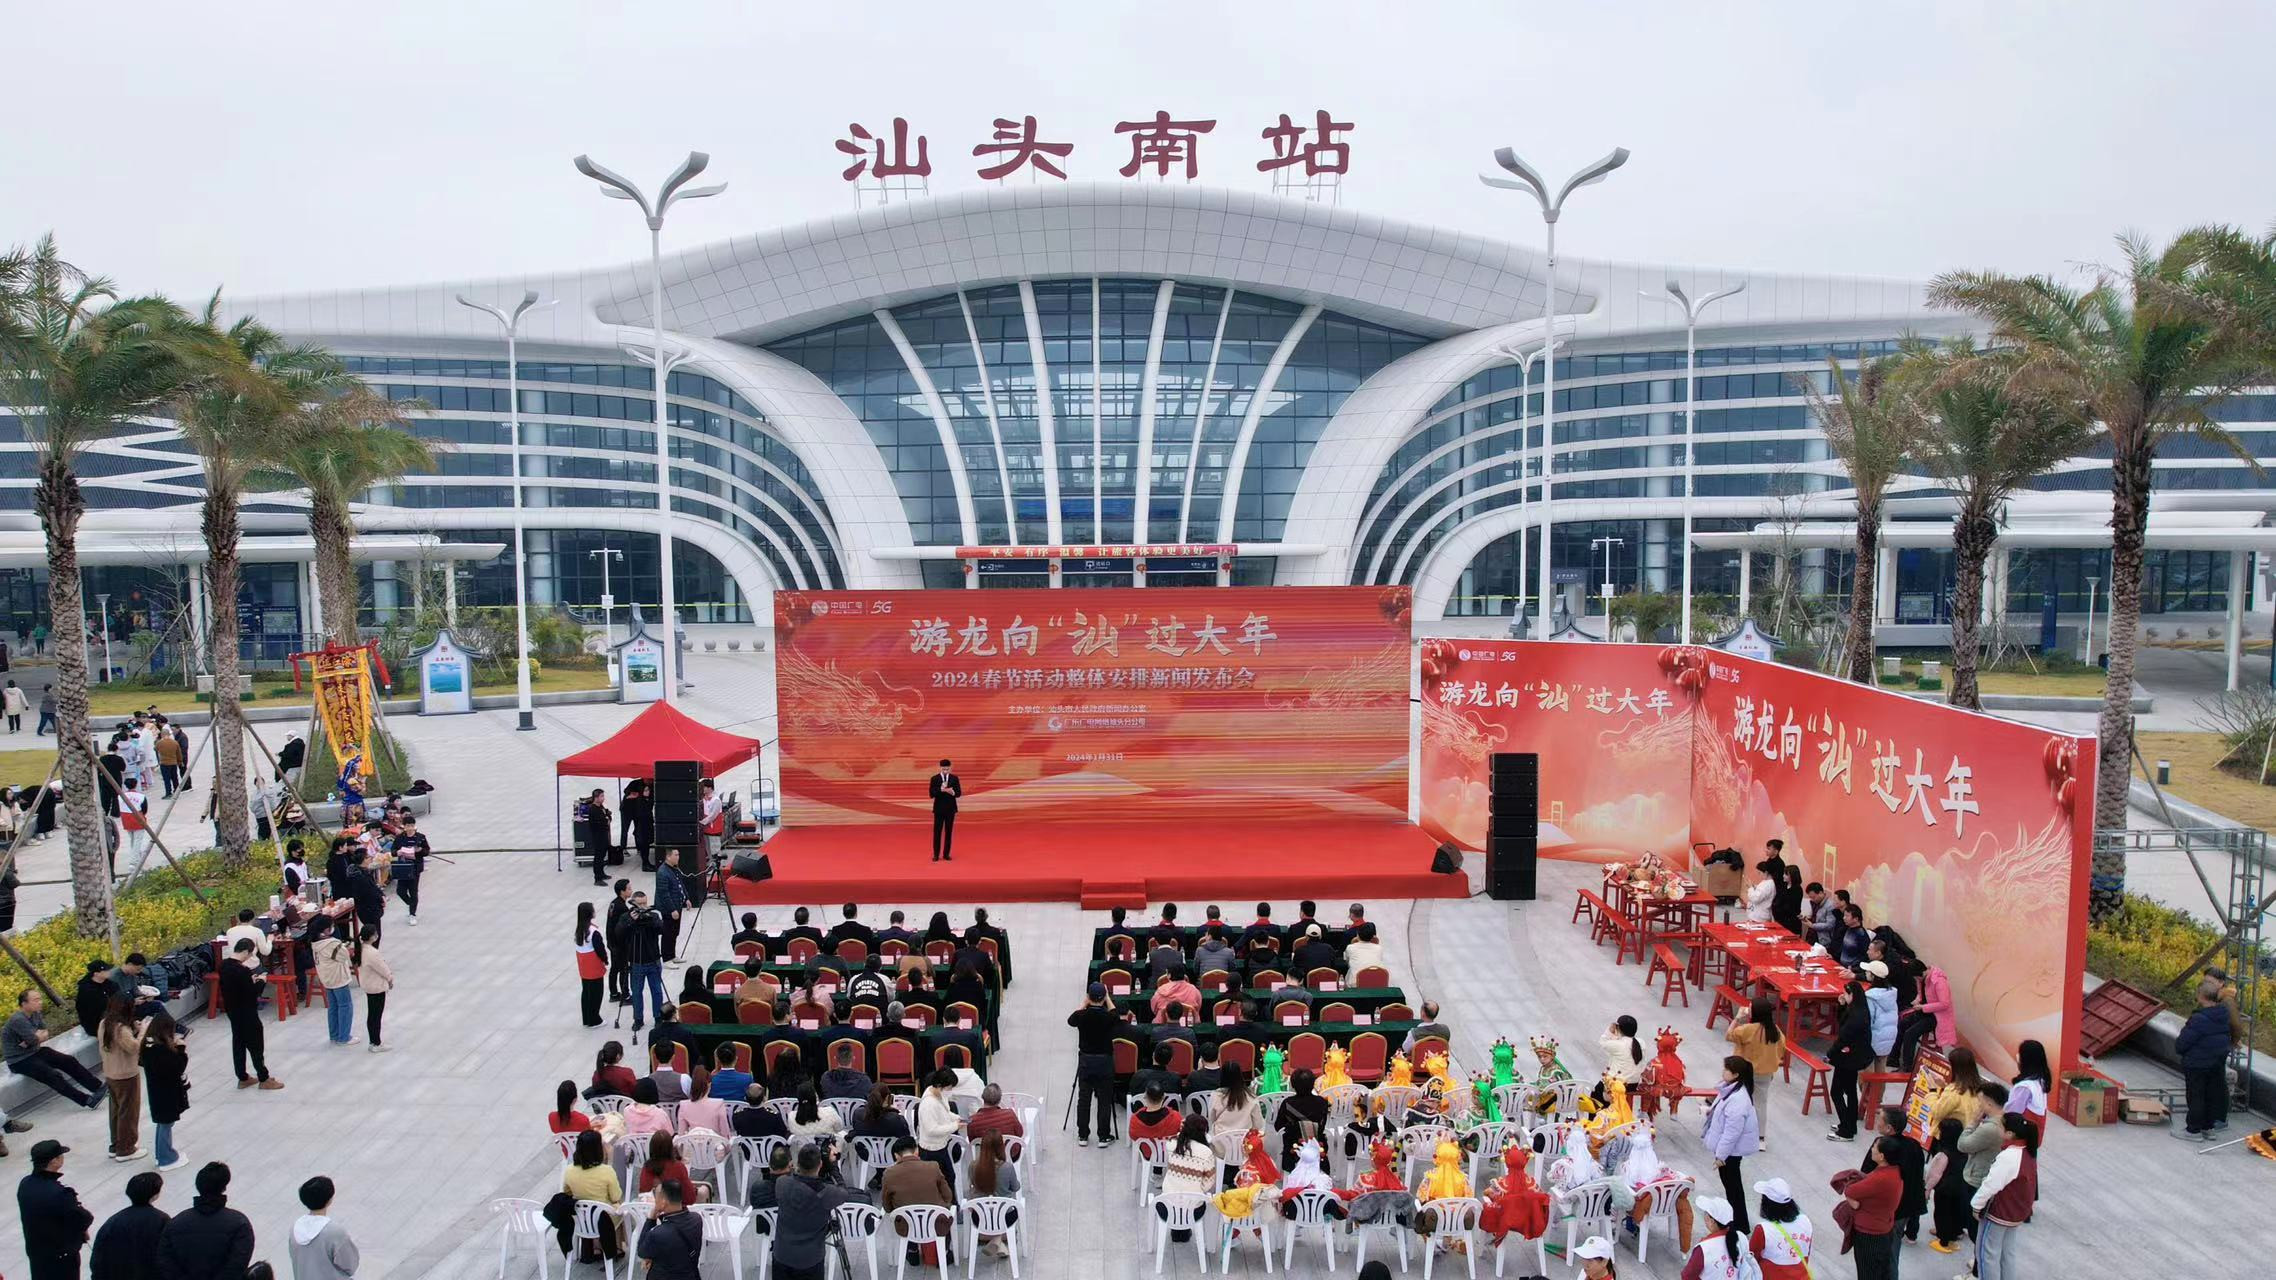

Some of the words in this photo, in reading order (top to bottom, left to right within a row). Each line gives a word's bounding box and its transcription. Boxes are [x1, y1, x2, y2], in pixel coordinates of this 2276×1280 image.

[835, 109, 1356, 181] 汕头南站
[990, 547, 1014, 557] 平安
[1024, 547, 1049, 557] 有序
[1060, 546, 1085, 557] 温馨
[1098, 545, 1205, 557] 让旅客体验更美好
[831, 601, 862, 609] 中国广电
[871, 601, 893, 614] 5G
[908, 607, 1278, 658] 游龙向“汕”过大年
[1500, 651, 1517, 662] 5G
[931, 666, 1257, 690] 2024春节活动整体安排新闻发布会
[1439, 679, 1674, 717] 游龙向“汕”过大年
[1065, 752, 1124, 761] 2024年1月31日
[1733, 695, 1980, 840] 游龙向“汕”过大年
